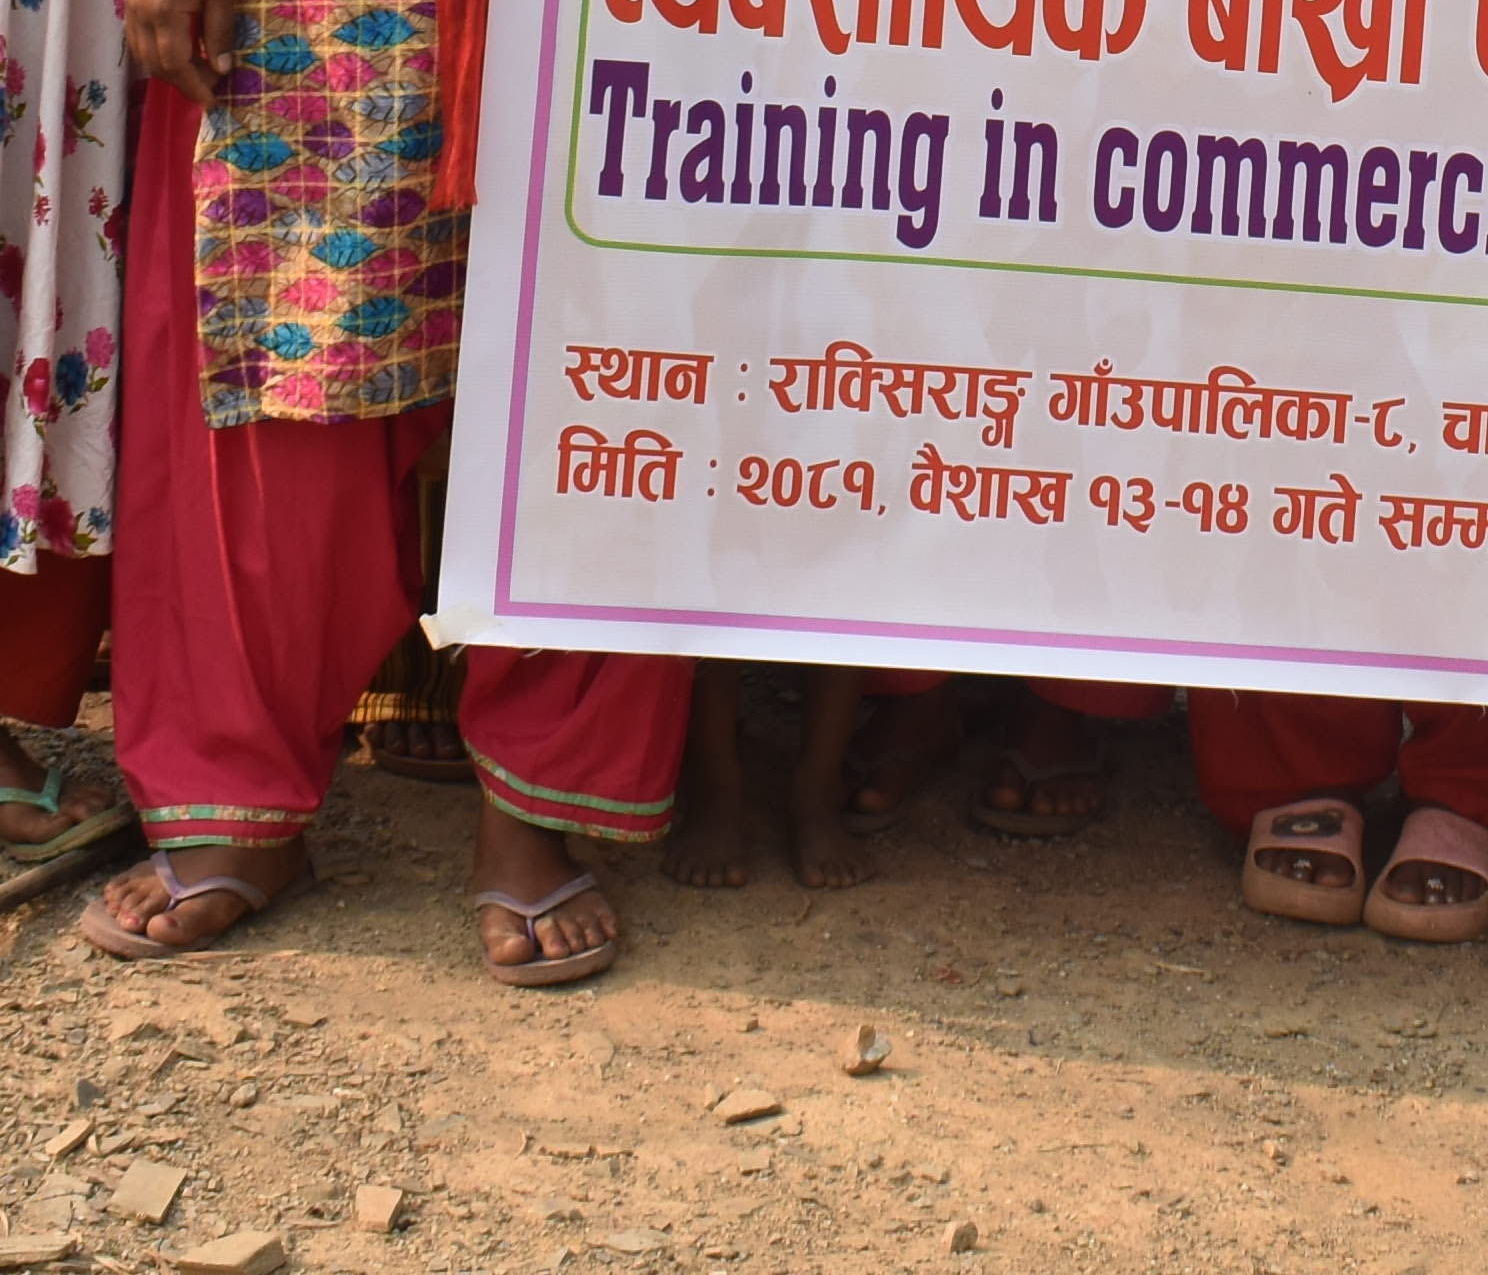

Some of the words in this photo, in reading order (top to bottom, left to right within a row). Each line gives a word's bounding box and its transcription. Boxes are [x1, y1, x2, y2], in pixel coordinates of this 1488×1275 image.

[589, 59, 949, 249] Training
[979, 88, 1057, 222] in
[565, 345, 714, 405] स्थान
[556, 424, 683, 502] मिति
[736, 456, 886, 516] २०८१,
[910, 442, 1073, 524] वैशाख
[1089, 474, 1249, 534] १३-१४
[1272, 473, 1362, 544] गते
